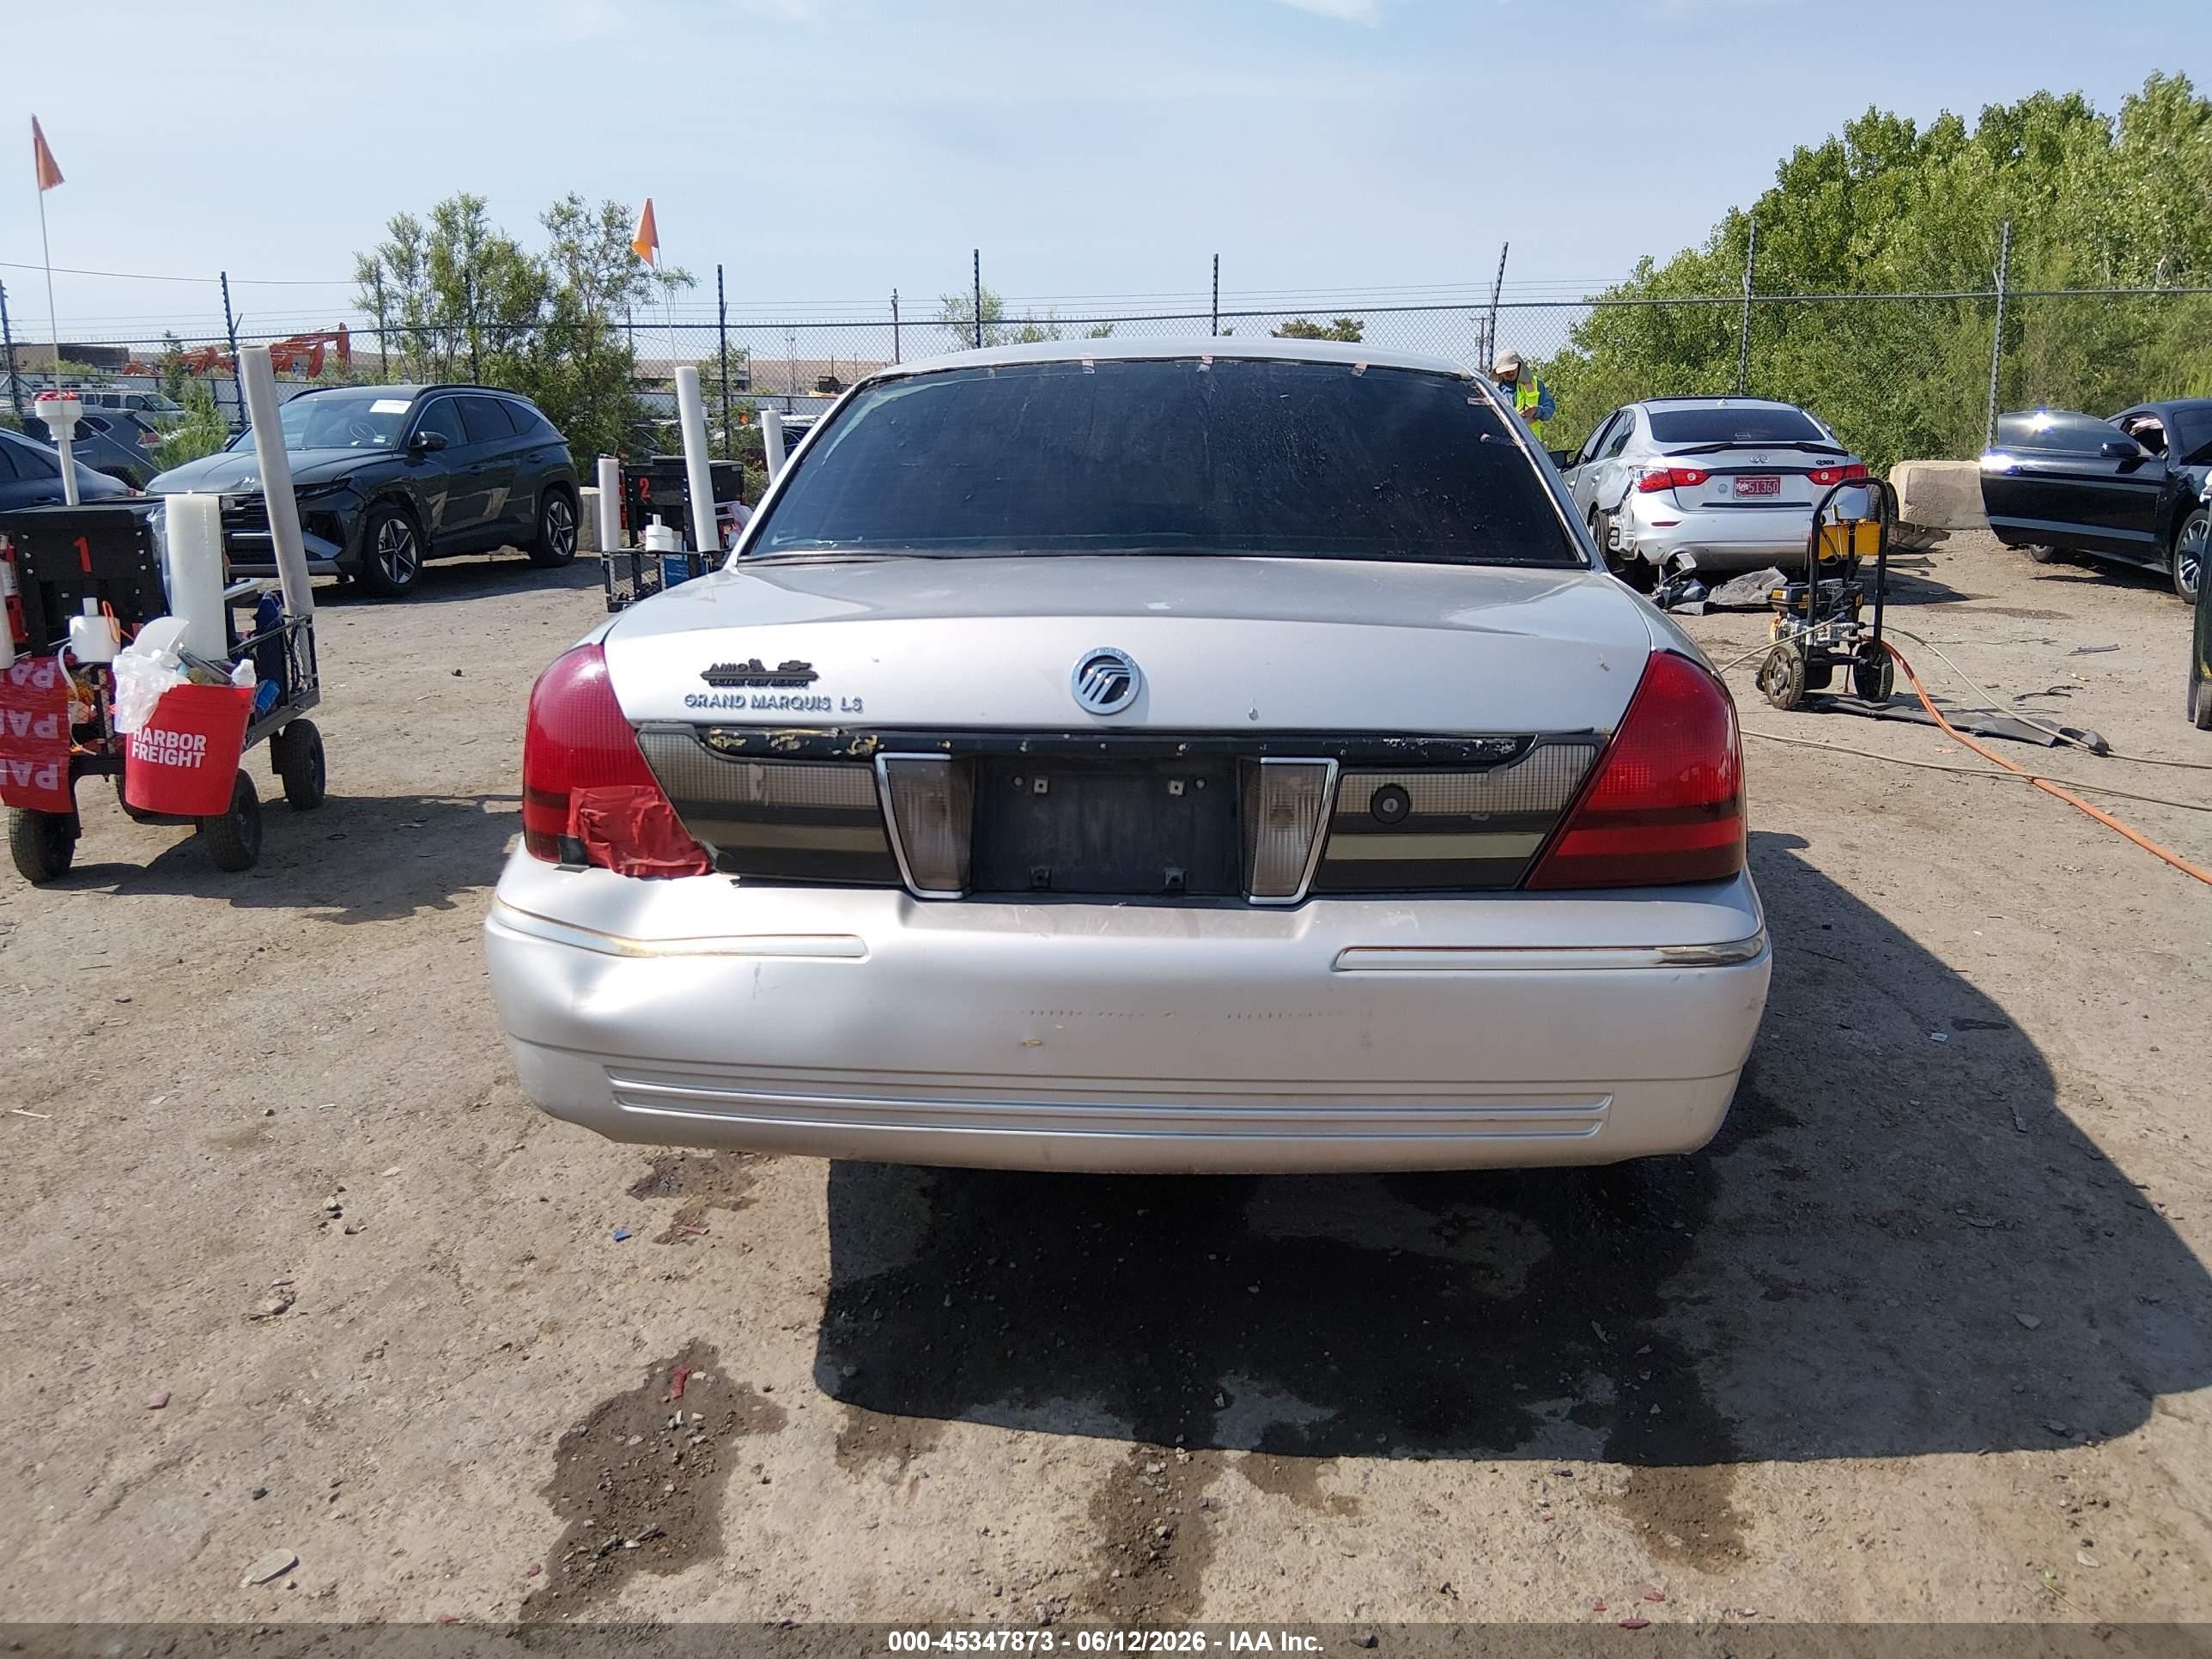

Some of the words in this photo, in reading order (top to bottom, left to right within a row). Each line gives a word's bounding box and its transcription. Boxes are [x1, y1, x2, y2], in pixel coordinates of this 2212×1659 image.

[638, 477, 651, 501] 2
[1748, 482, 1779, 493] 51360
[73, 536, 93, 573] 1
[684, 693, 746, 710] GRAND
[750, 694, 832, 711] MARQUIS
[840, 696, 864, 712] LS
[133, 726, 207, 751] HARBOR
[131, 741, 207, 769] FREIGHT
